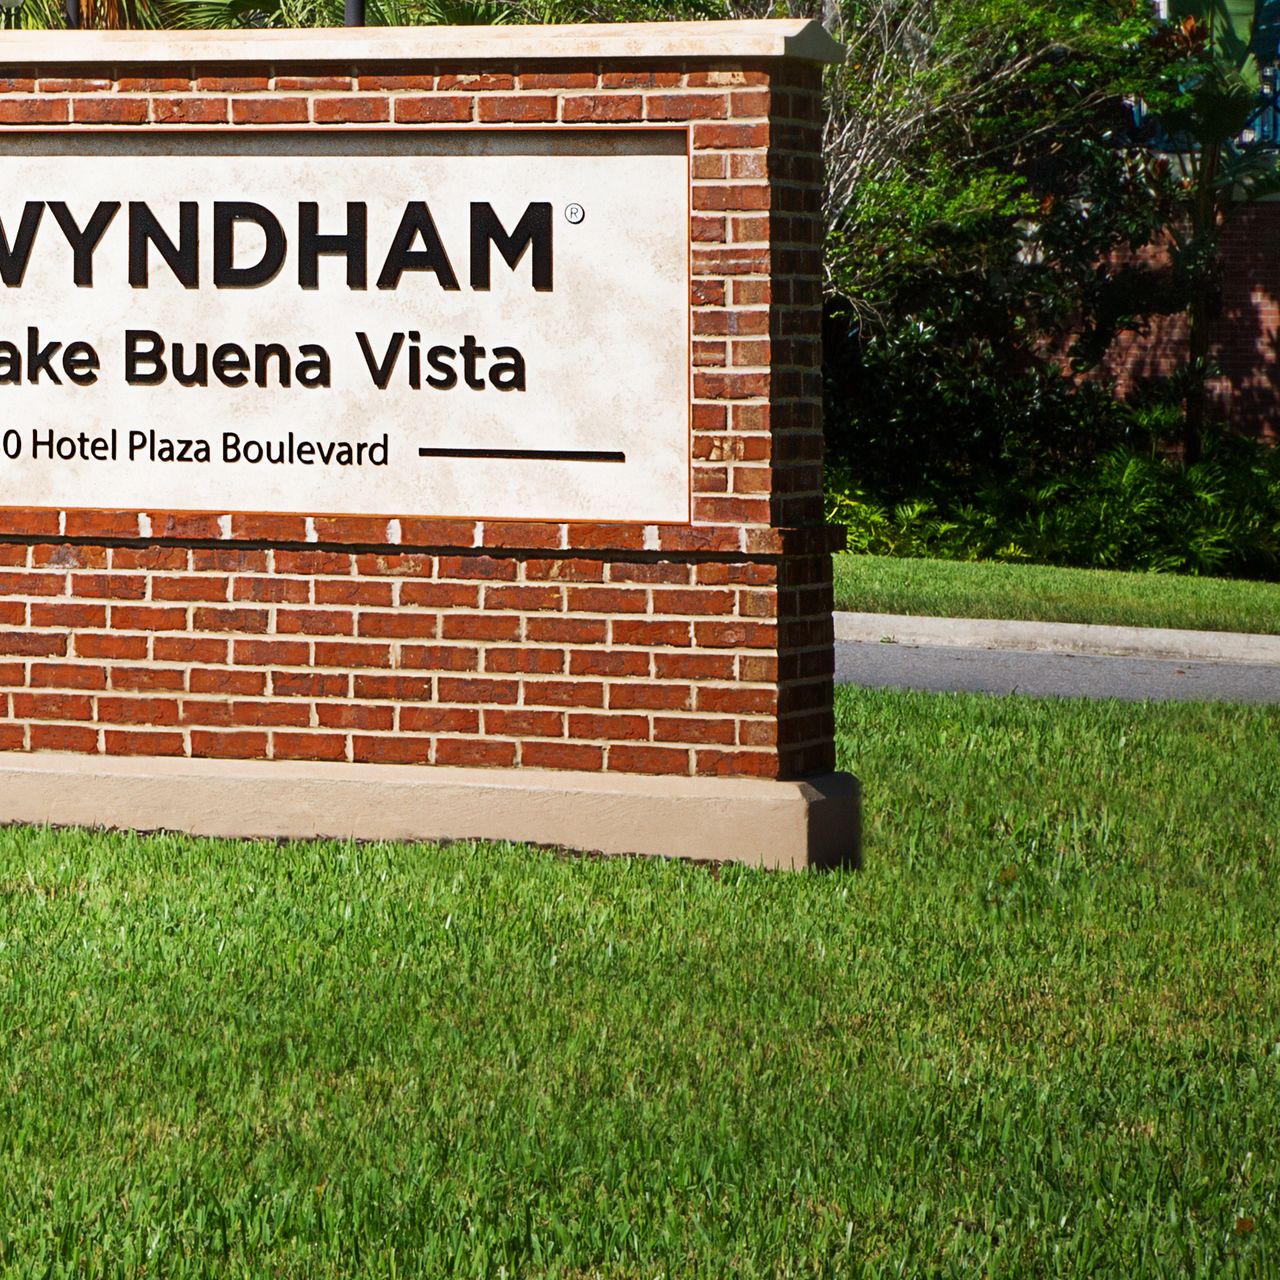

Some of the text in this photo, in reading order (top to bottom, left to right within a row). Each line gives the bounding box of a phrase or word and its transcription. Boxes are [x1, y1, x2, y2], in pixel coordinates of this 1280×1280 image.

[125, 329, 331, 389] Buena
[356, 330, 527, 393] Vista
[32, 428, 117, 462] Hotel
[128, 429, 211, 463] Plaza
[222, 431, 389, 466] Boulevard
